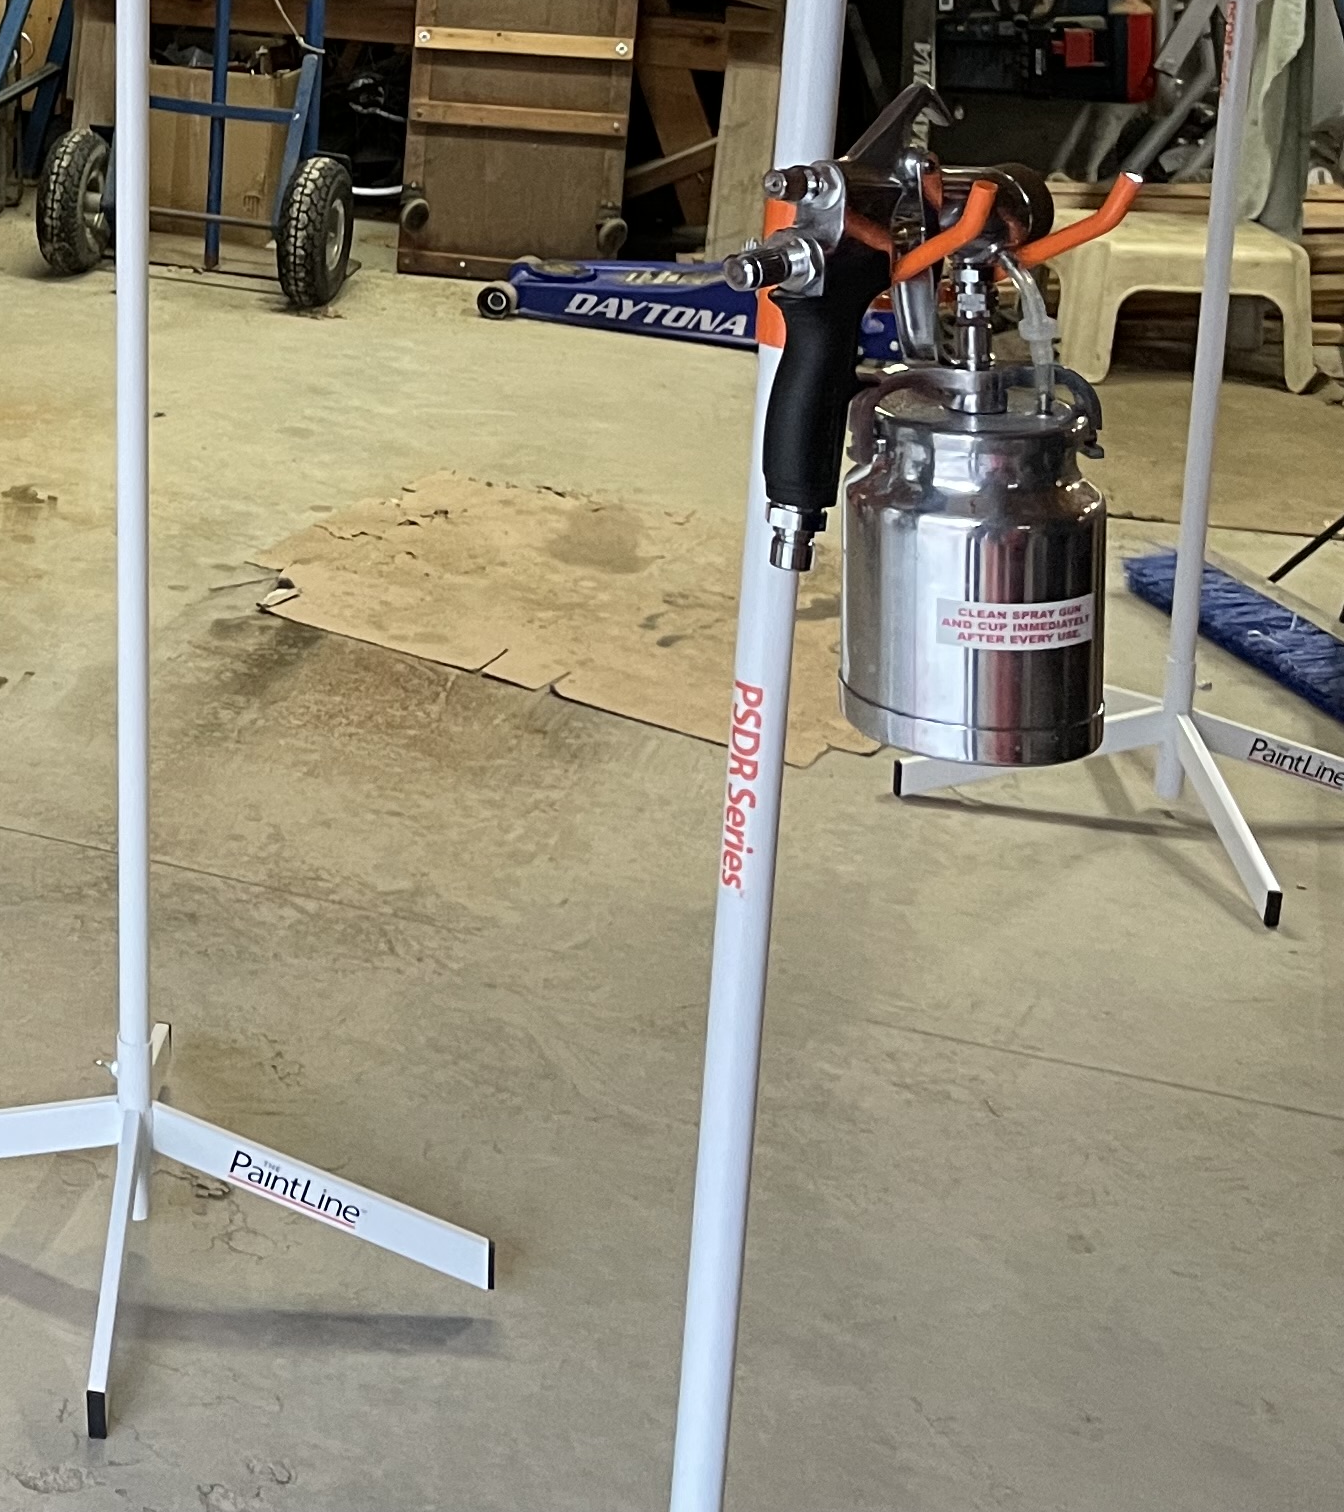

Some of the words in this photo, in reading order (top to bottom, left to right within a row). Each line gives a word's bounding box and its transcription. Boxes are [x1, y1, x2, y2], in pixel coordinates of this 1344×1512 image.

[564, 292, 749, 337] DAYTONA
[941, 618, 973, 630] AND
[978, 622, 1009, 632] CUP
[1012, 613, 1091, 632] IMMEDIATELY
[958, 607, 1007, 620] CLEAN
[1012, 609, 1056, 620] SPRAY
[1058, 604, 1083, 617] GUN
[957, 631, 1006, 644] AFTER
[1010, 633, 1056, 645] EVERY
[729, 679, 764, 782] PSDR
[1249, 738, 1344, 787] PaintLine
[722, 782, 757, 890] Series
[229, 1149, 361, 1224] PaintLine
[264, 1160, 281, 1173] THE
